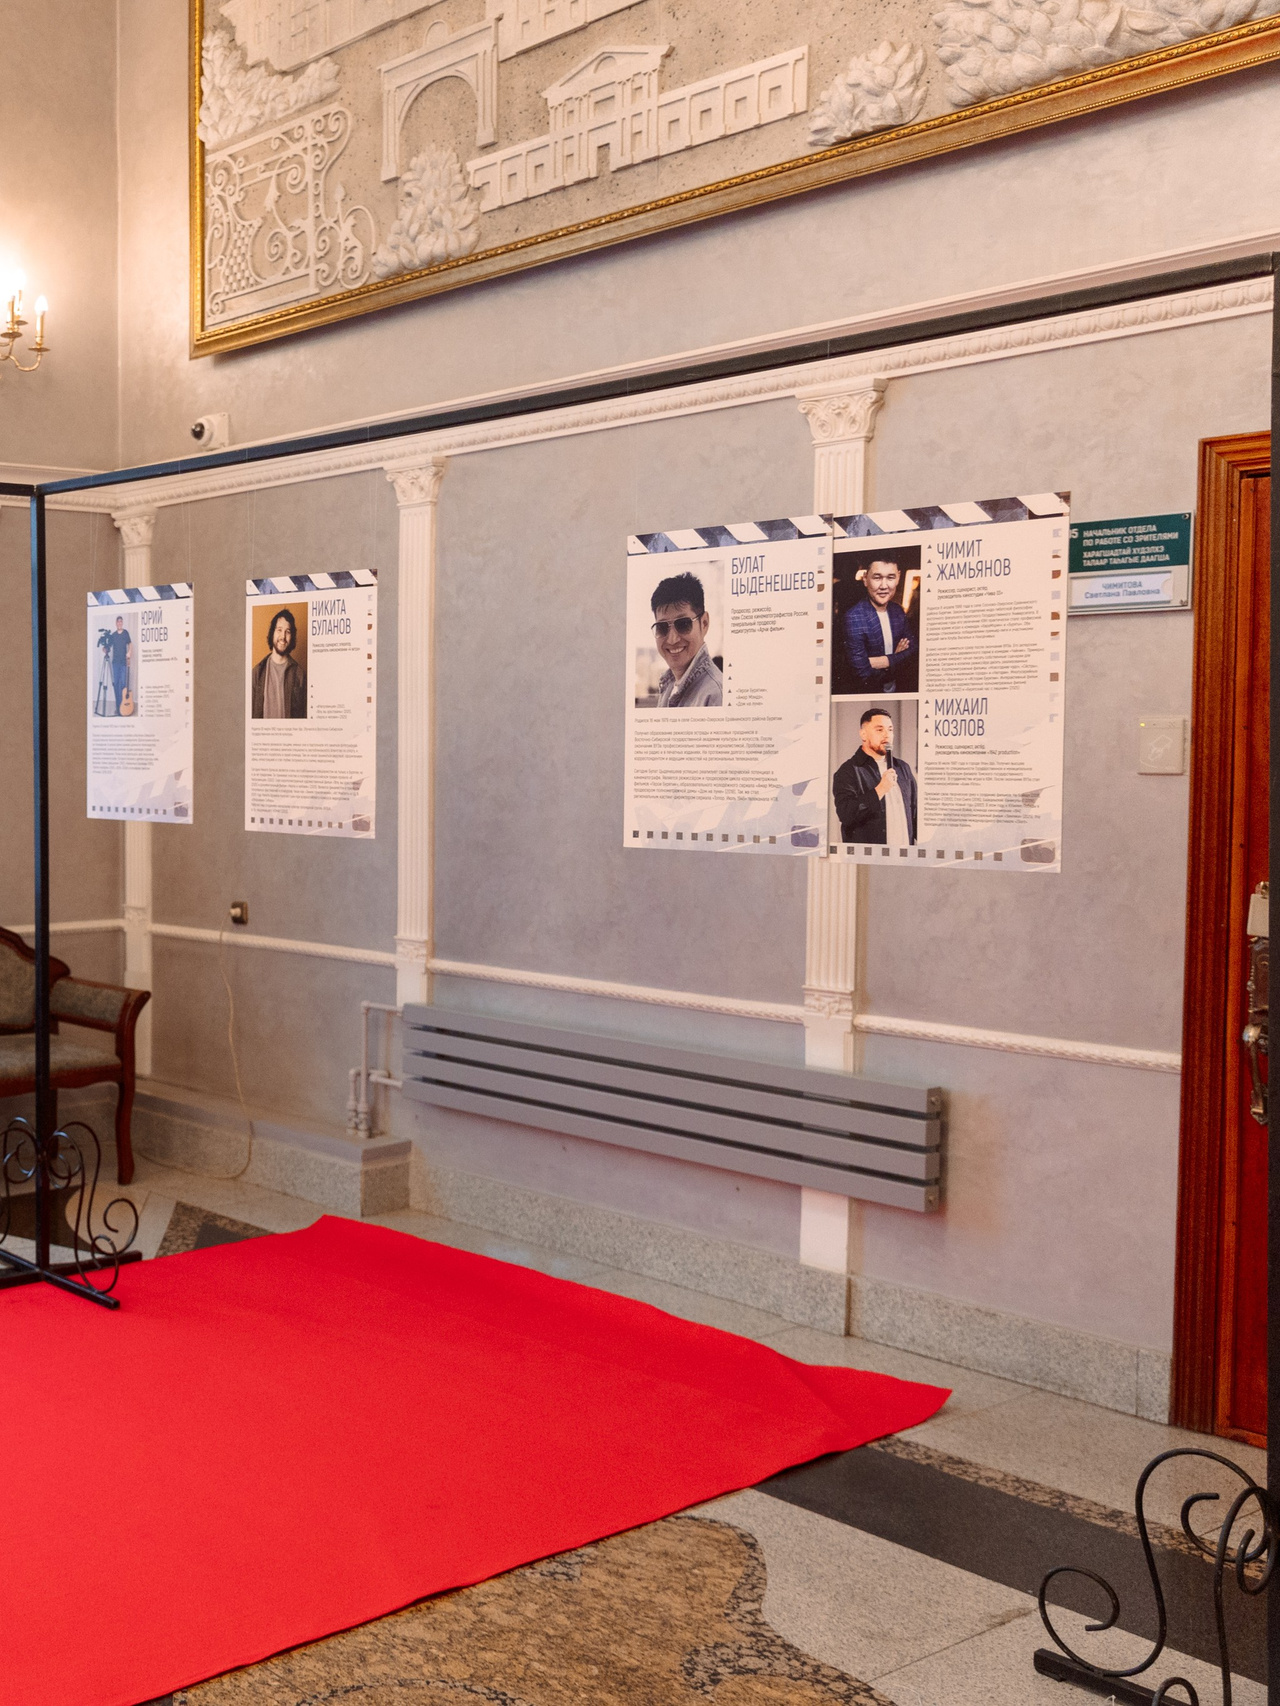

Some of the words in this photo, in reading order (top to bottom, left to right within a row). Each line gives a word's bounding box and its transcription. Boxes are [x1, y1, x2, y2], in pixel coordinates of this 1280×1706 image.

[1083, 527, 1127, 538] НАЧАЛЬНИК
[1128, 524, 1157, 534] ОТДЕЛА
[1083, 539, 1094, 547] ПО
[1095, 537, 1122, 546] РАБОТЕ
[1123, 535, 1133, 543] СО
[1135, 532, 1179, 543] ЗРИТЕЛЯМИ
[936, 538, 983, 560] ЧИМИТ
[731, 554, 766, 576] БУЛАТ
[936, 557, 1011, 582] ЖАМЬЯНОВ
[731, 570, 815, 597] ЦЫДЕНЕШЕЕВ
[1084, 591, 1121, 599] Светлана
[1122, 588, 1160, 597] Павловна
[1102, 580, 1142, 589] ЧИМИТОВА
[141, 606, 163, 626] ЮРИЙ
[311, 598, 347, 616] НИКИТА
[141, 627, 169, 643] БОТОЕВ
[311, 617, 352, 637] БУЛАНОВ
[934, 697, 988, 717] МИХАИЛ
[934, 718, 985, 738] КОЗЛОВ
